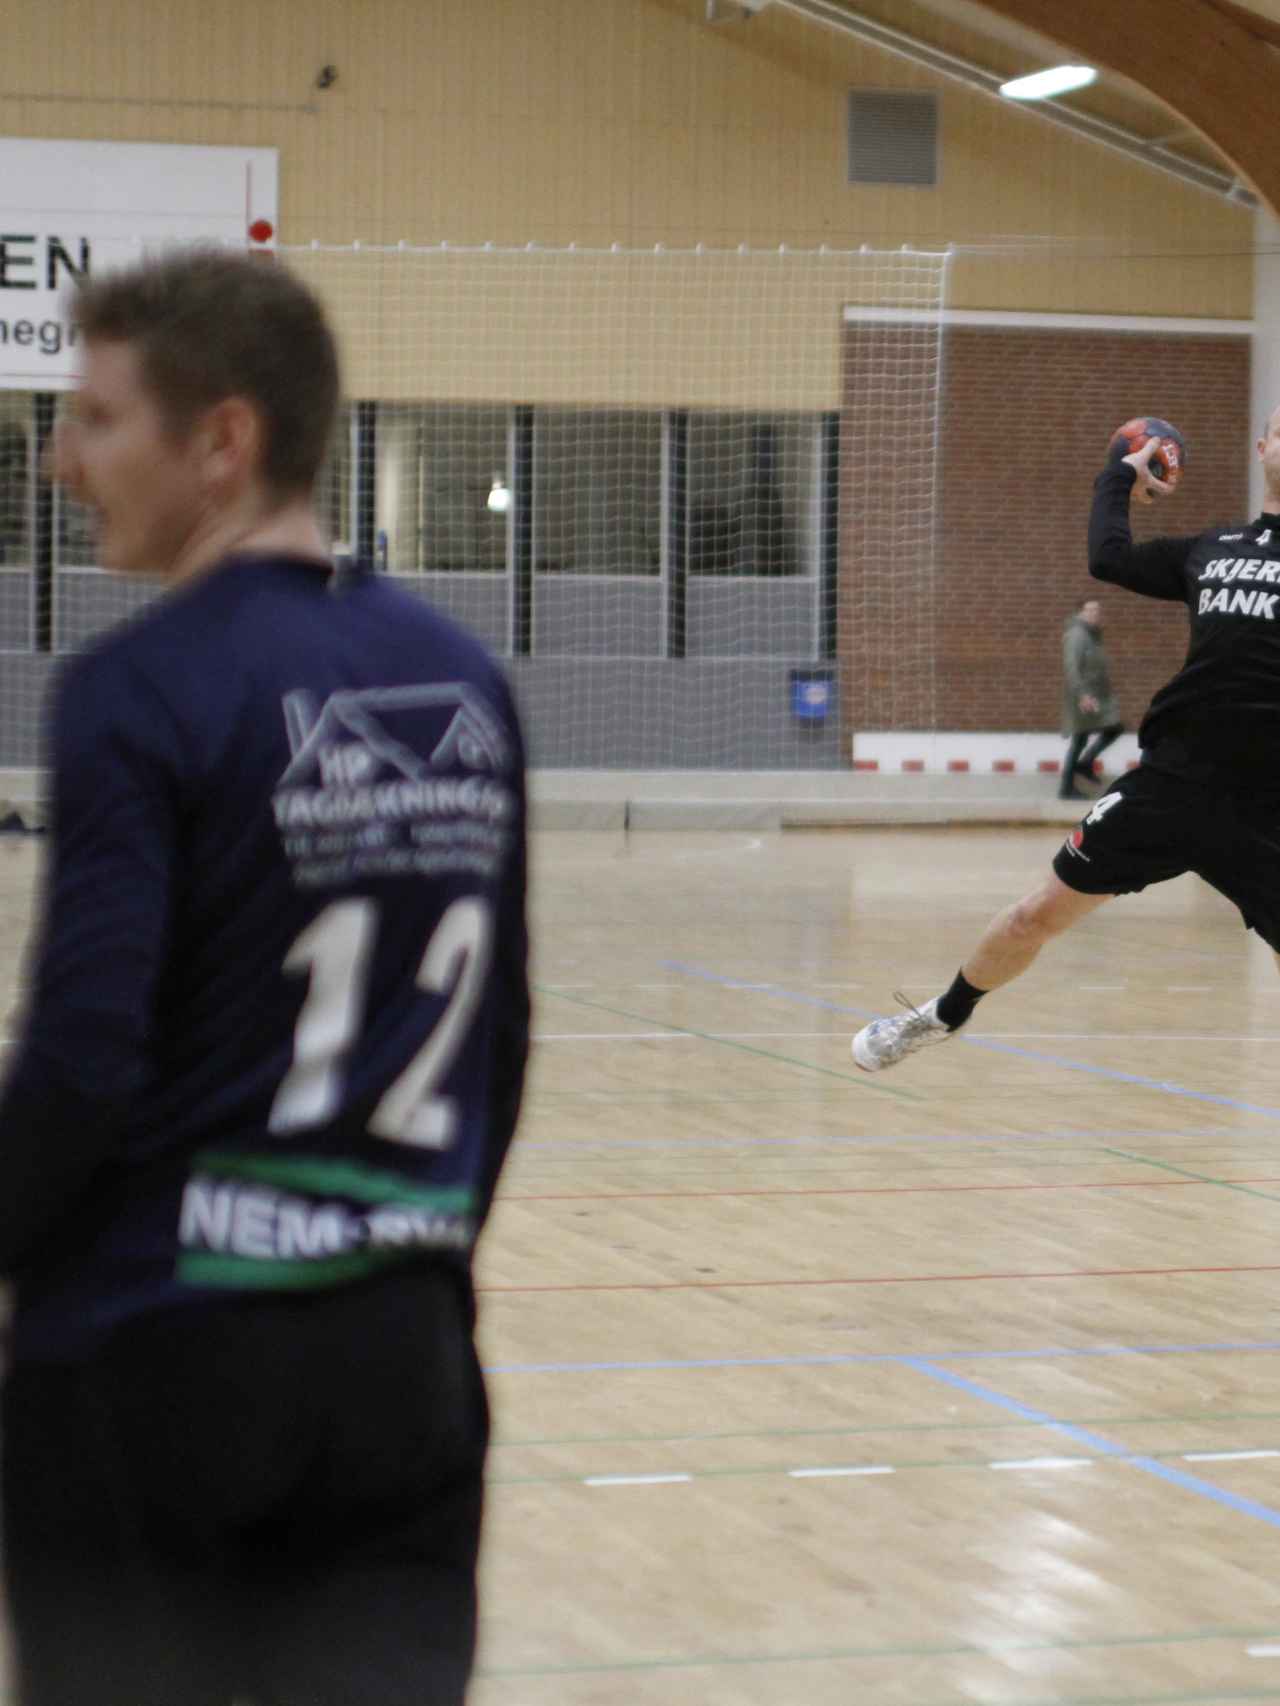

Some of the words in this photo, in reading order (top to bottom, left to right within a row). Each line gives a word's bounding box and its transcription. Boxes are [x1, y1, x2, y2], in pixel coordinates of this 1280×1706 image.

[1255, 528, 1272, 545] 4
[1198, 588, 1280, 620] BANK
[1086, 791, 1123, 825] 4
[266, 896, 493, 1150] 12
